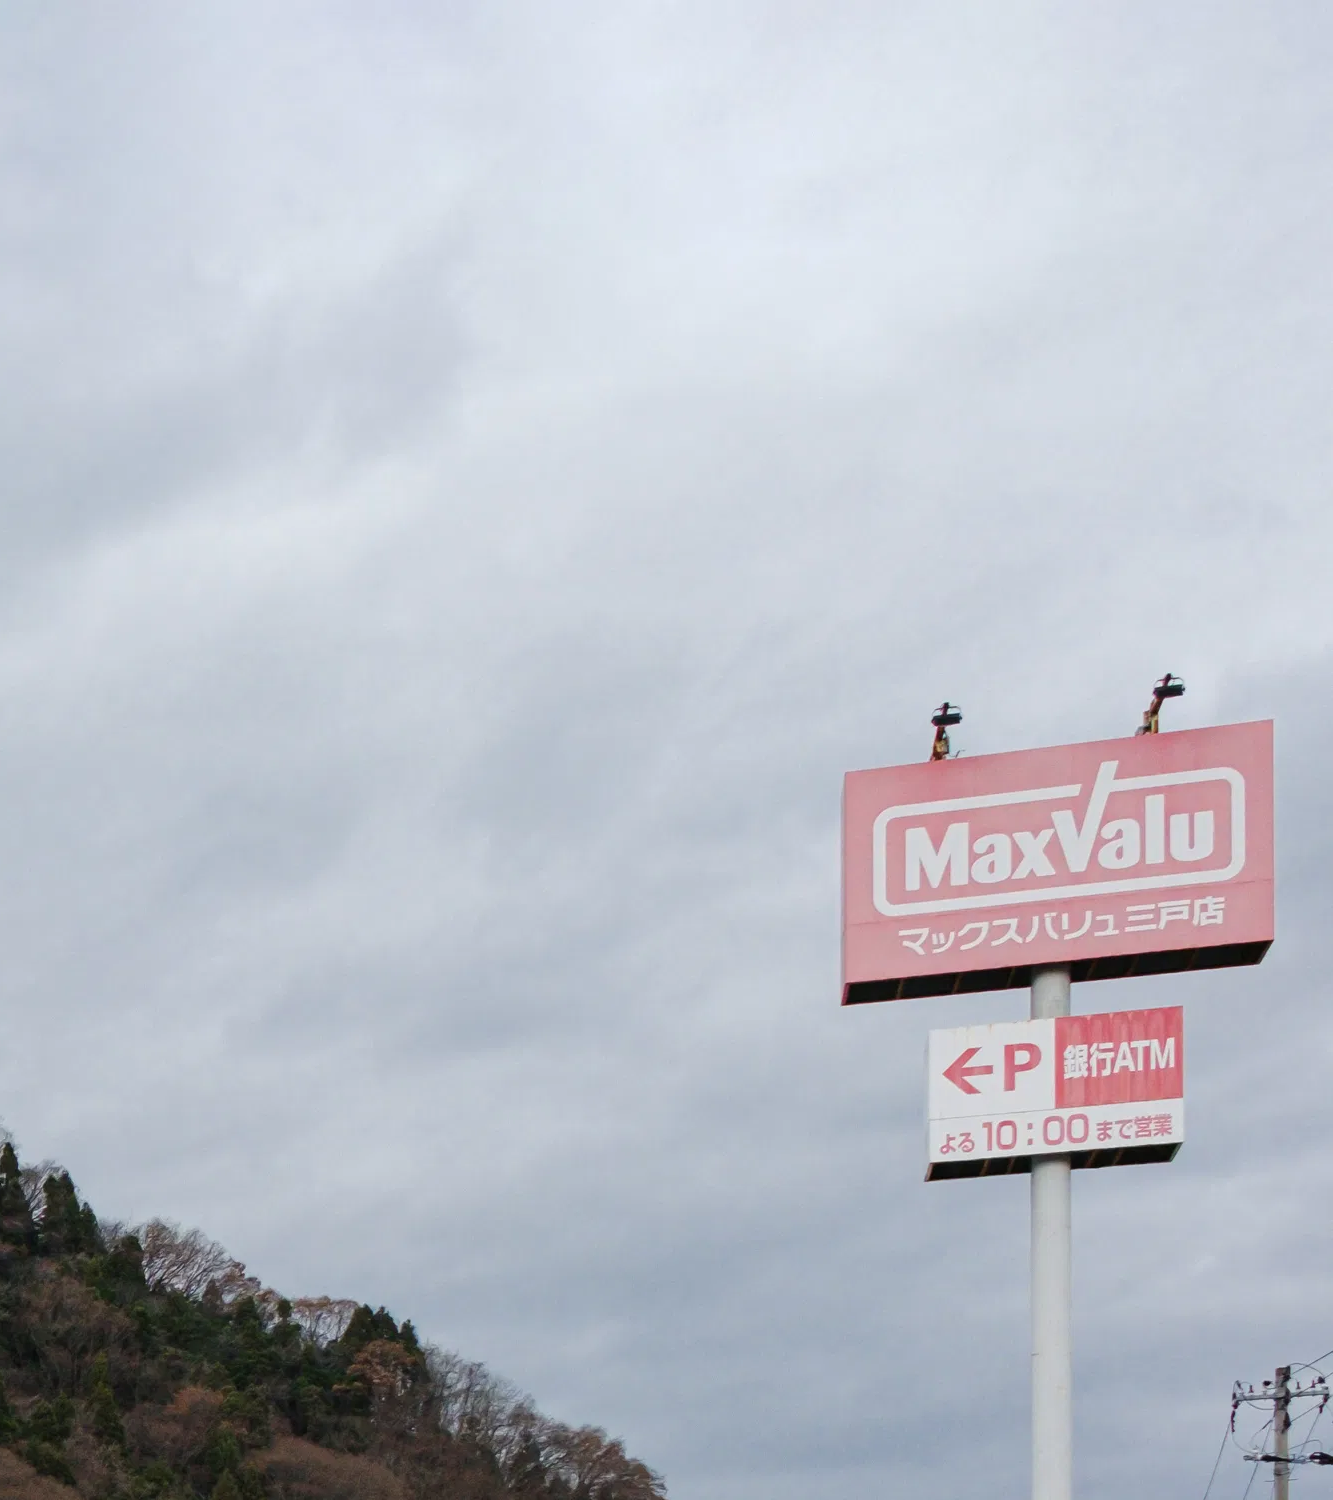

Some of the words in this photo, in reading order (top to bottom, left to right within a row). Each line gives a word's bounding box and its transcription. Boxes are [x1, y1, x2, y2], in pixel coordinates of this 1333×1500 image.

[904, 760, 1214, 892] MaxValu
[897, 895, 1227, 956] マックスバリュ三戸店
[1003, 1042, 1042, 1092] P
[1062, 1036, 1176, 1080] 銀行ATM
